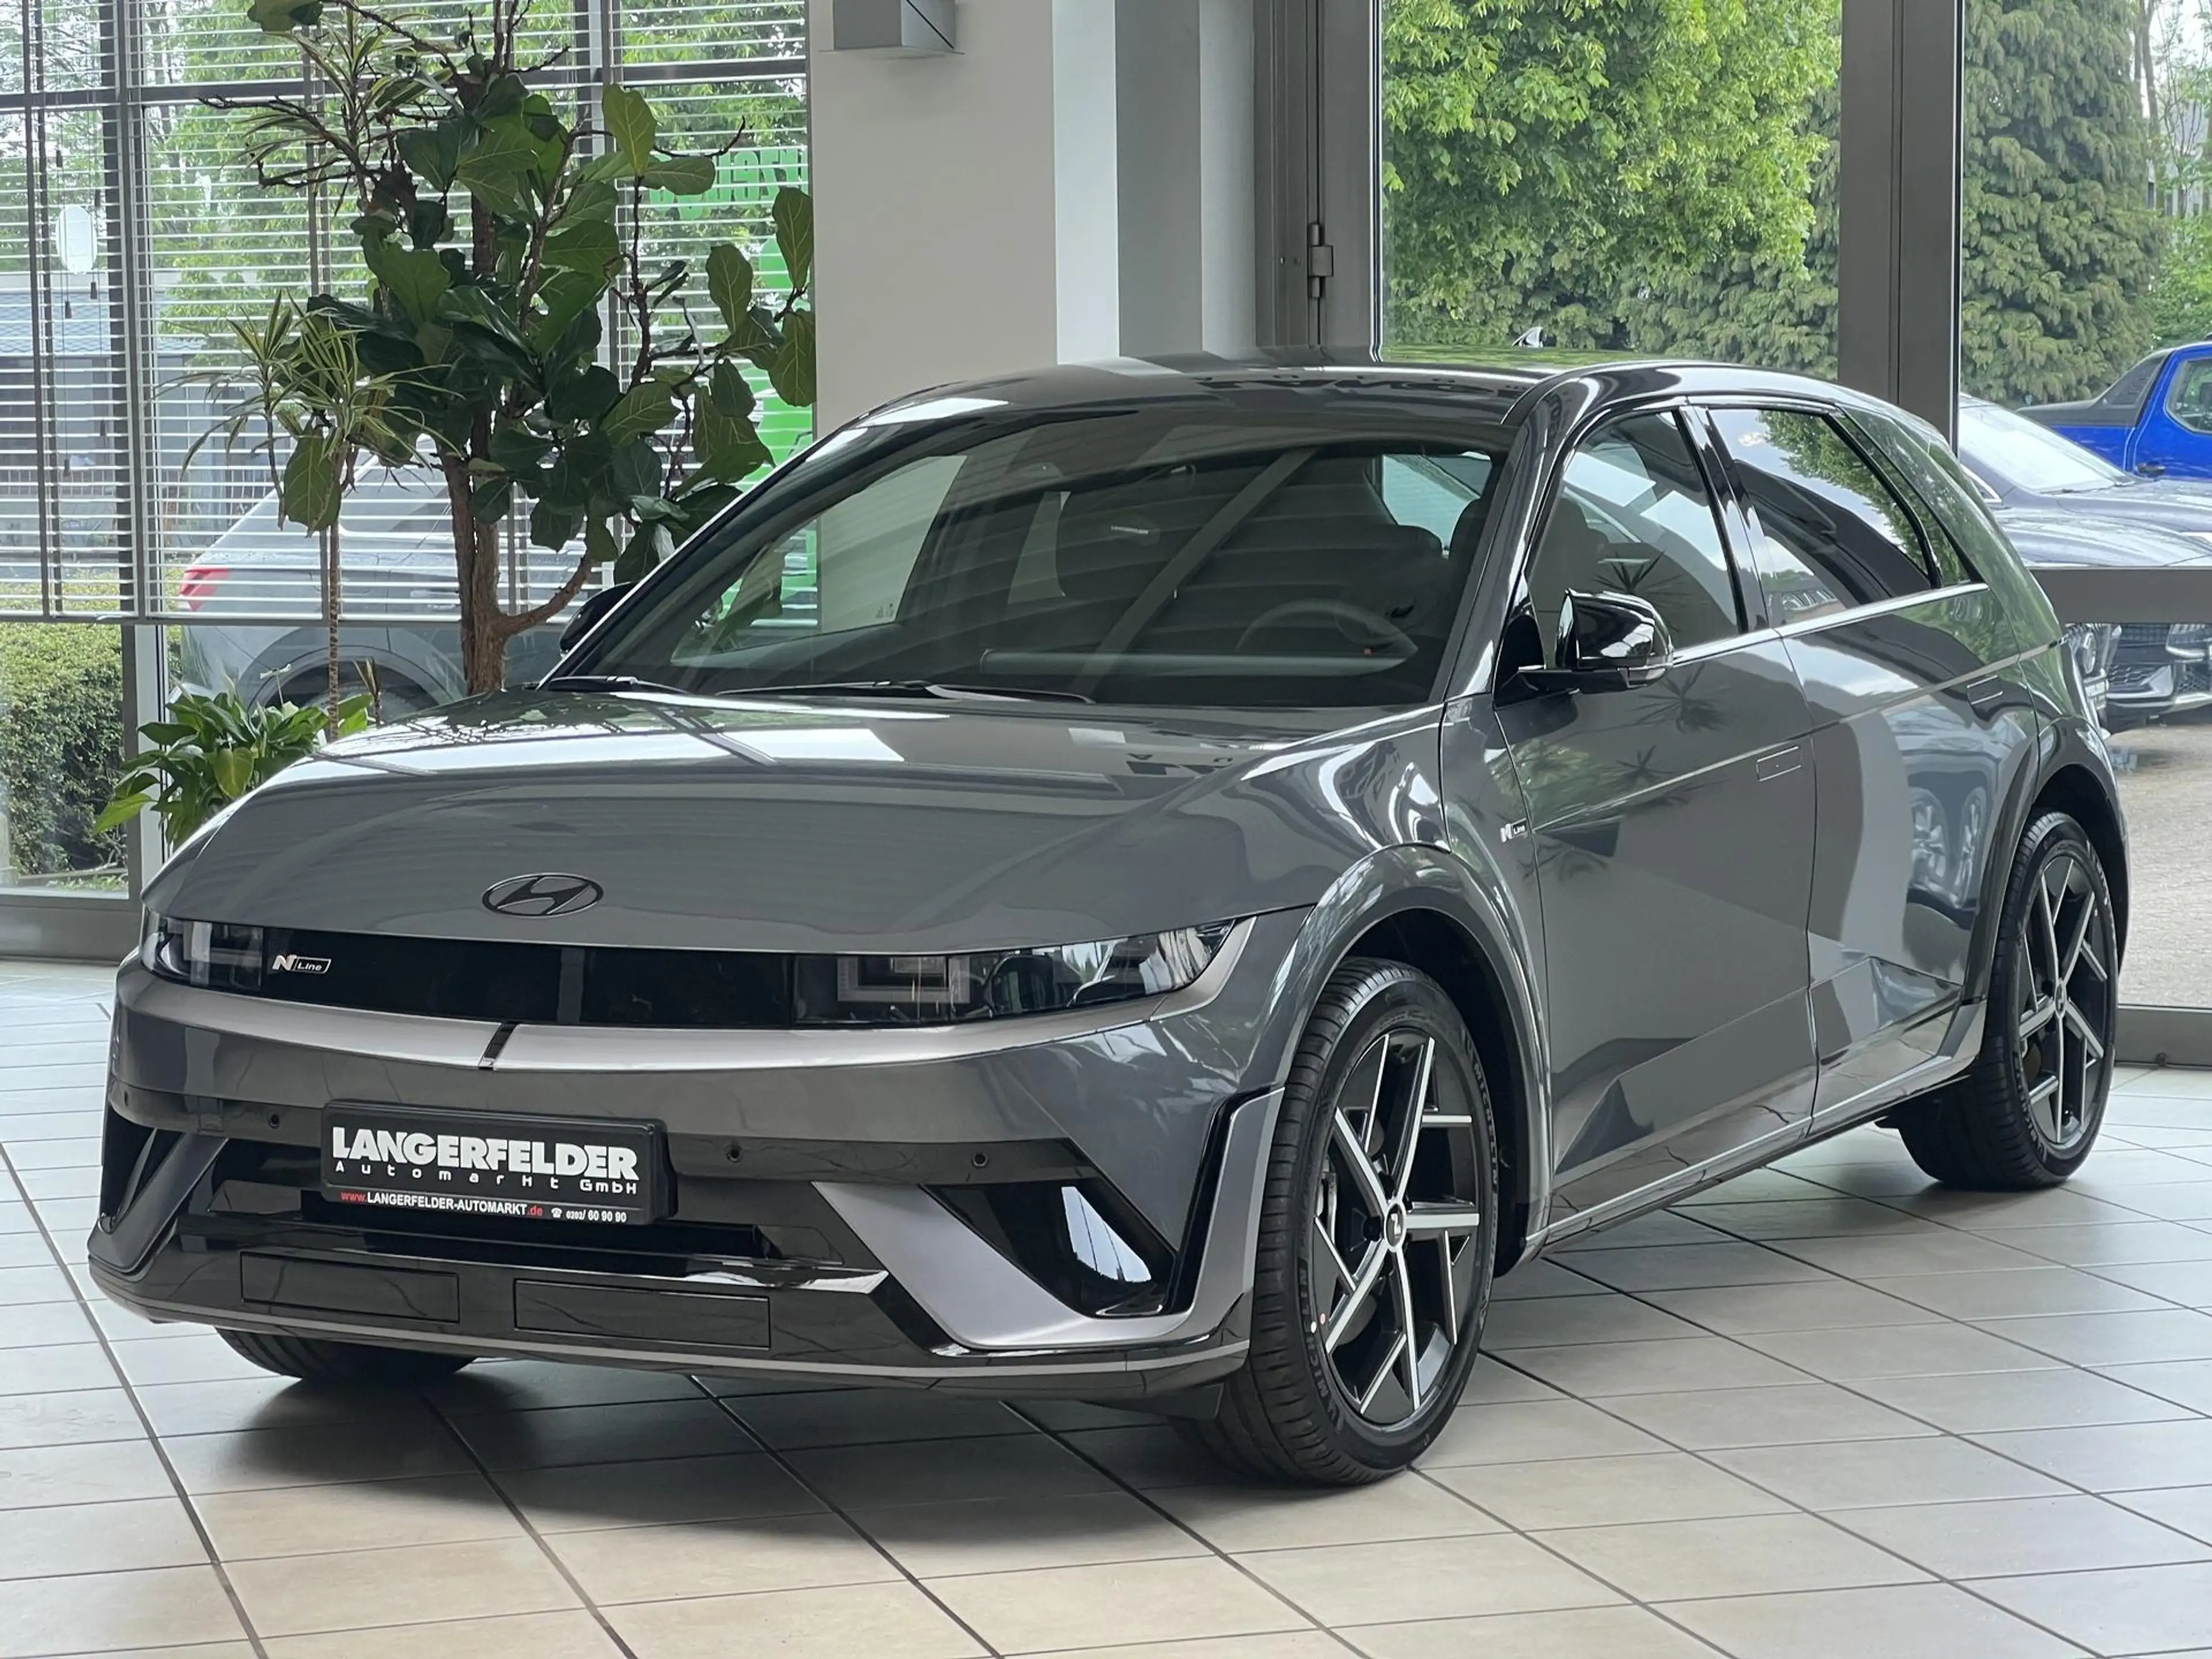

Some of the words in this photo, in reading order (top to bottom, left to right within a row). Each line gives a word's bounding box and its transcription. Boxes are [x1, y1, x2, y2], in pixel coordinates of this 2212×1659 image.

[272, 955, 297, 971] N
[297, 961, 323, 971] Line
[332, 1126, 639, 1181] LANGERFELDER
[579, 1179, 637, 1194] GmbH
[341, 1191, 543, 1216] www.LANGERFELDER-AUTOMARKT.de
[588, 1210, 599, 1221] 60
[601, 1210, 613, 1222] 90
[615, 1211, 627, 1222] 90
